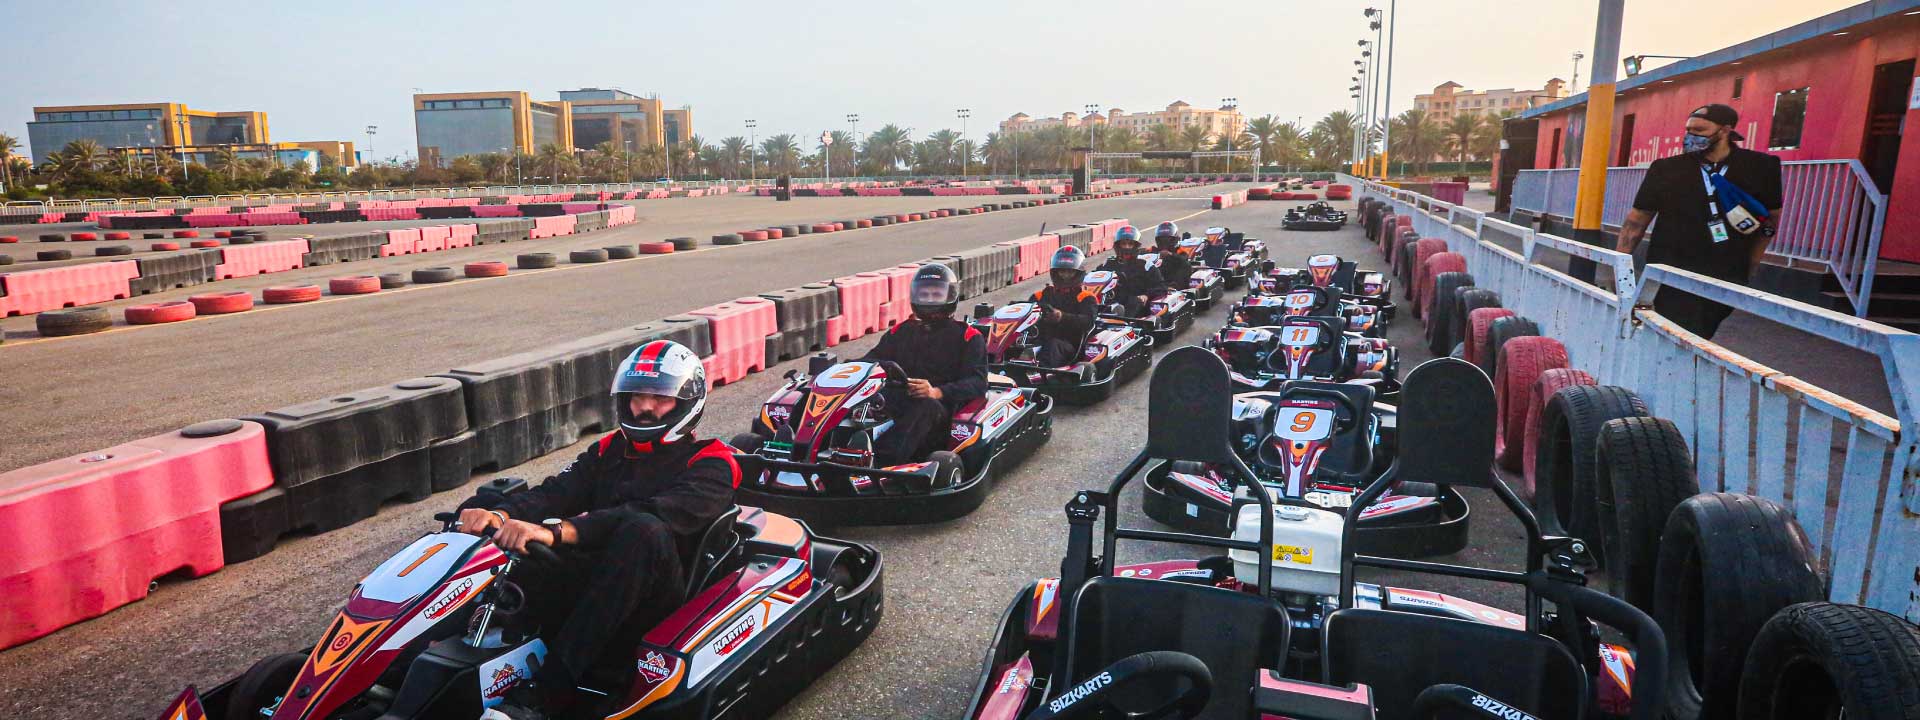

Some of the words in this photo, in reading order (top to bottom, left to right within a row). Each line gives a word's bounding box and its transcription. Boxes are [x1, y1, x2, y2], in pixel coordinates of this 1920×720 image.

[1291, 295, 1310, 304] 10
[1292, 329, 1309, 341] 11
[831, 365, 861, 379] 2
[1290, 411, 1317, 432] 9
[397, 543, 449, 577] 1
[423, 578, 474, 620] KARTING
[713, 615, 756, 654] KARTING
[639, 660, 669, 677] KARTING
[483, 668, 524, 697] KARTING
[1051, 671, 1112, 713] BIZKARTS
